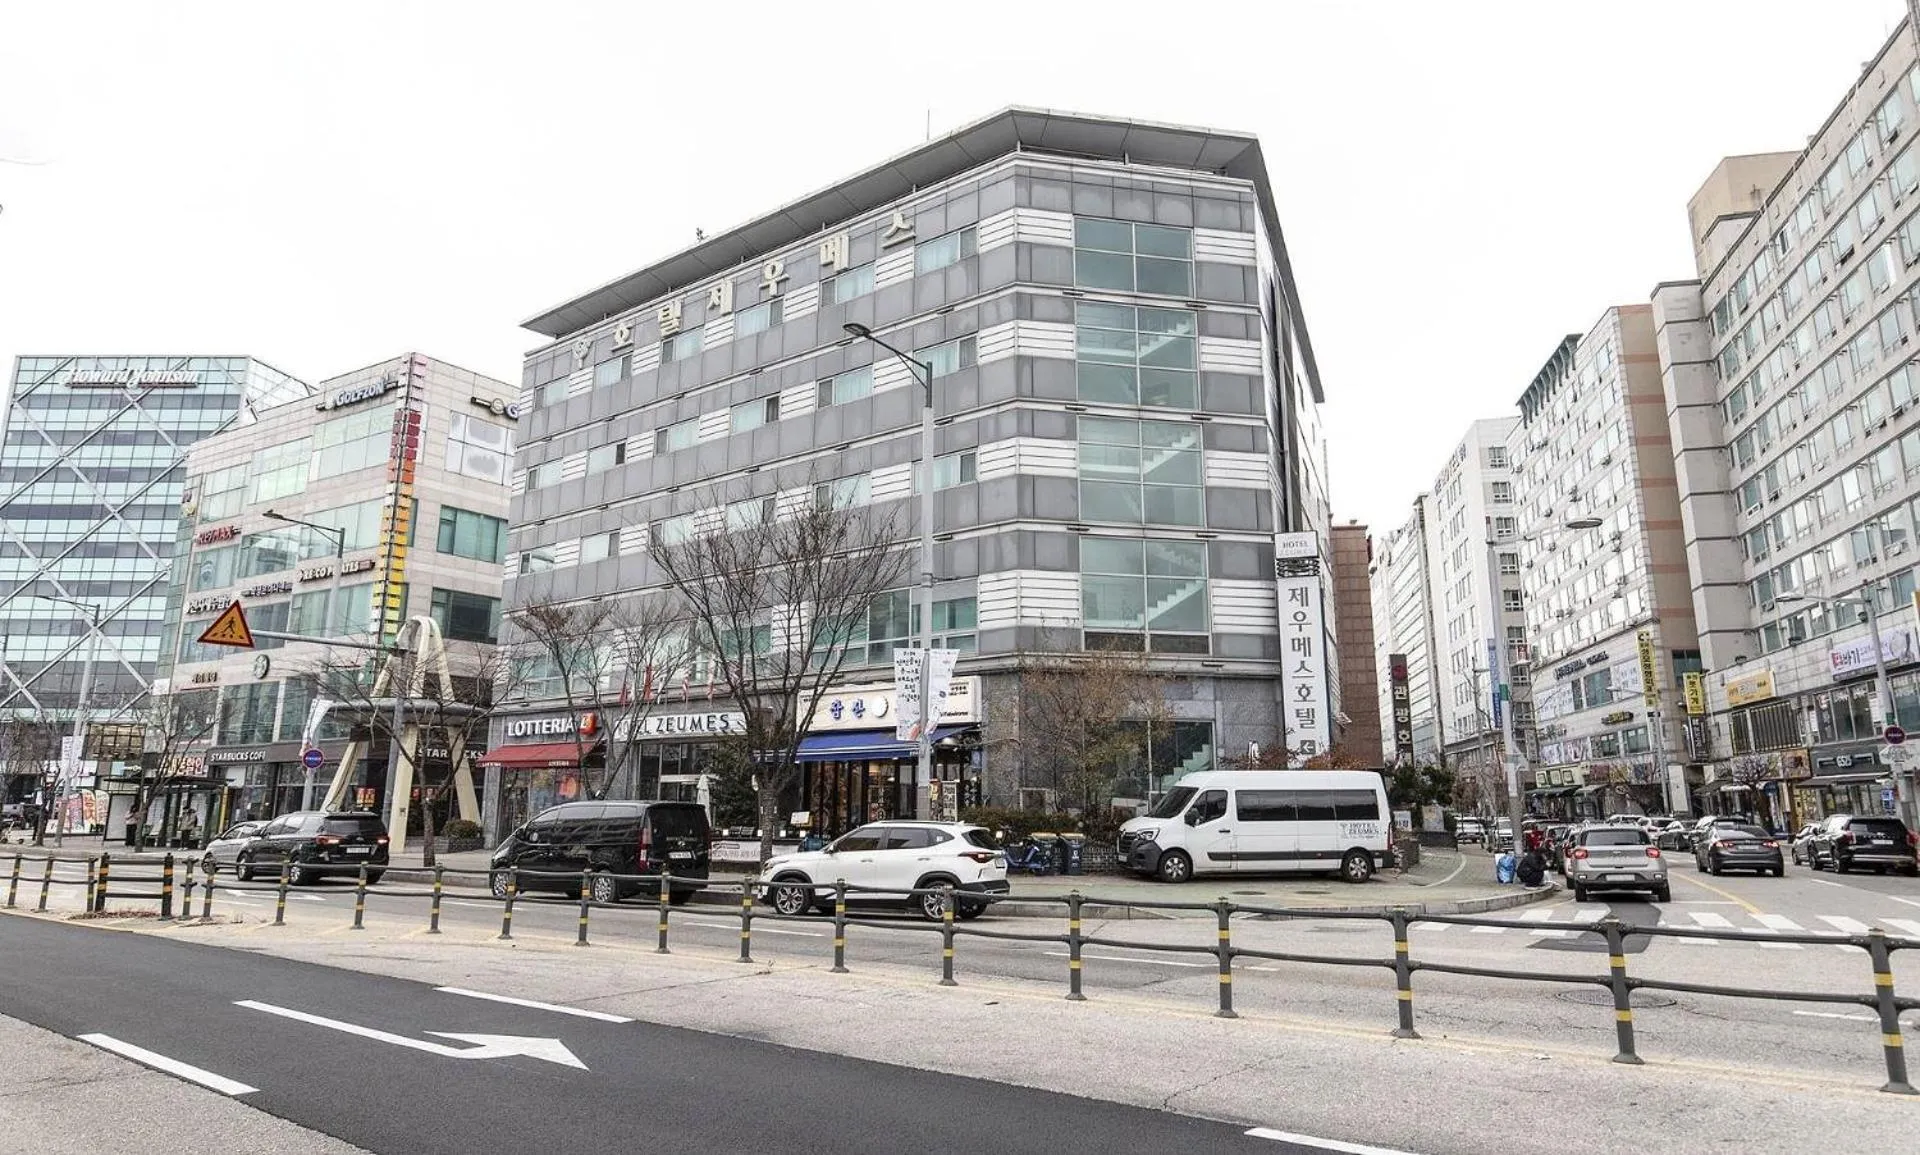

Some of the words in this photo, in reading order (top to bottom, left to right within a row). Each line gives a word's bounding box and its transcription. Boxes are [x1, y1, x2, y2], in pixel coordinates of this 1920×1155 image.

[67, 368, 129, 383] Howard
[127, 368, 199, 388] Johnson
[336, 379, 385, 406] GOLFZON
[1287, 586, 1317, 729] 제우메스호텔
[508, 717, 575, 737] LOTTERIA
[656, 713, 730, 733] ZEUMES
[210, 752, 249, 762] STARBUCKS
[417, 748, 485, 760] STARCKS
